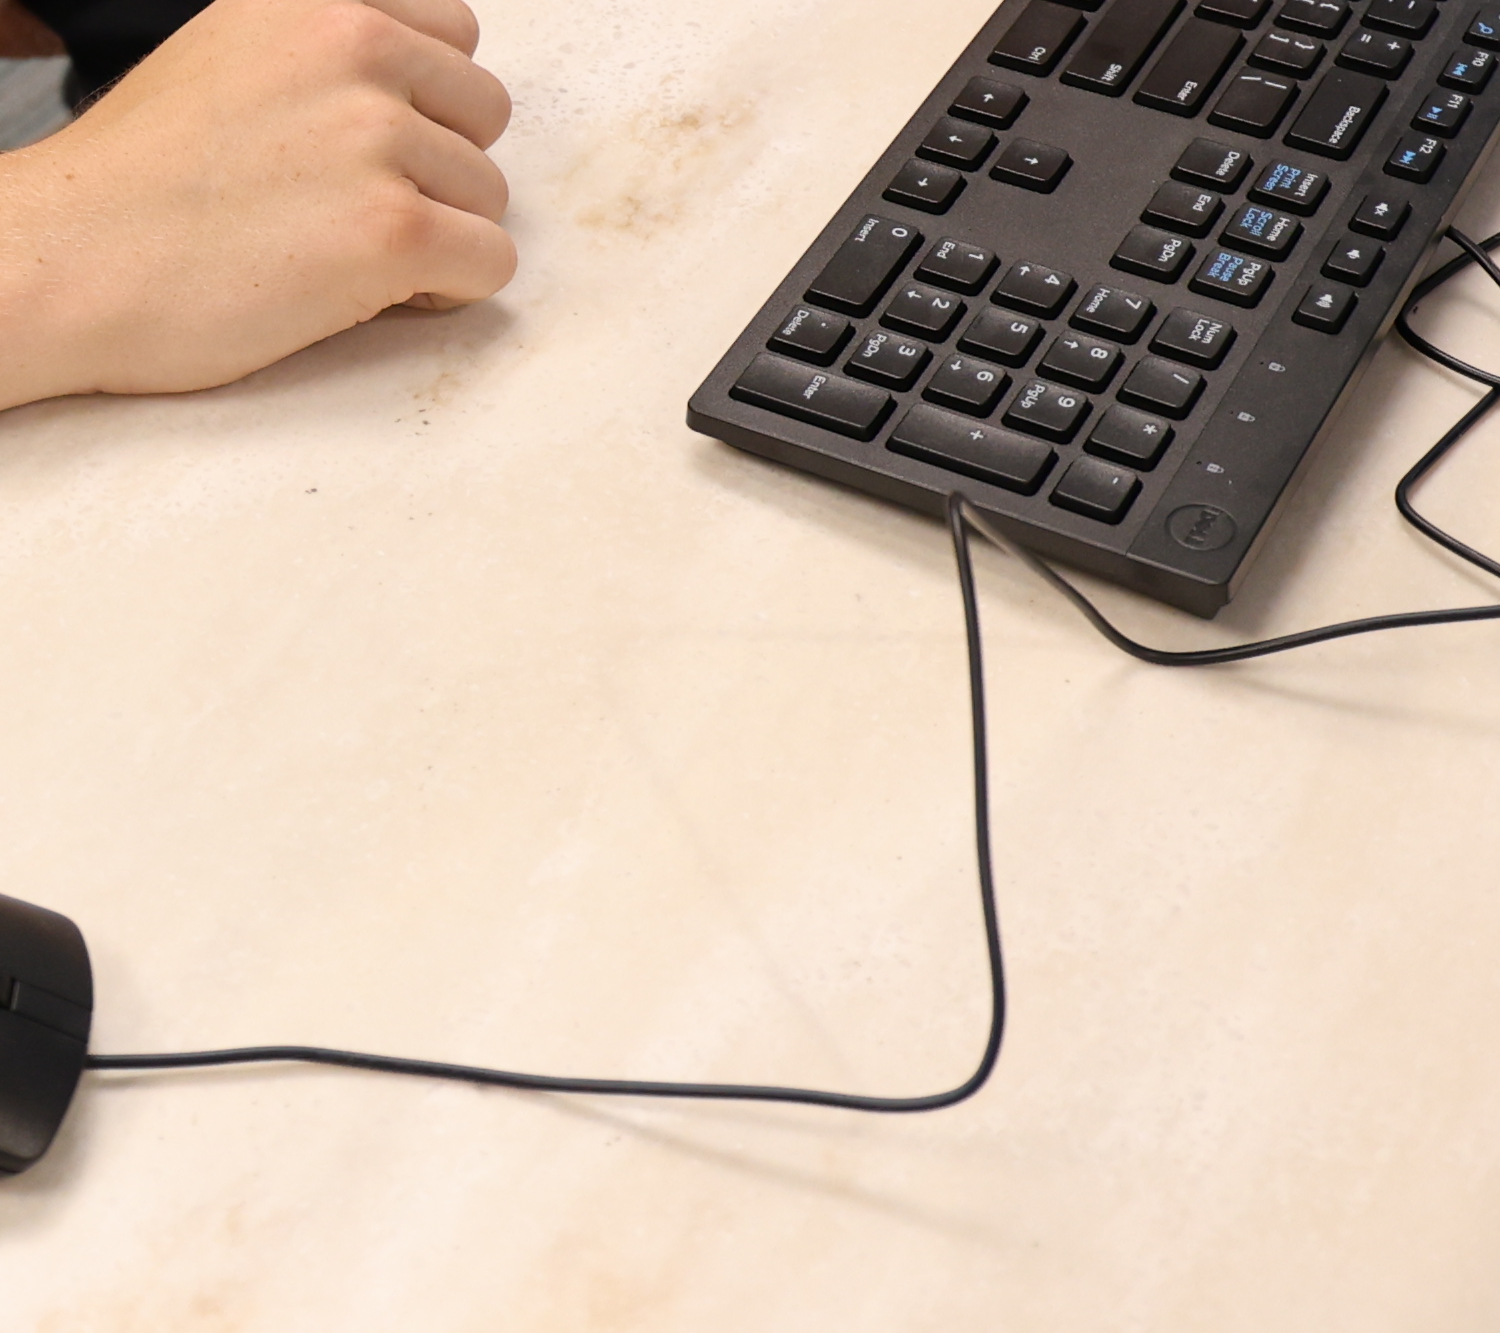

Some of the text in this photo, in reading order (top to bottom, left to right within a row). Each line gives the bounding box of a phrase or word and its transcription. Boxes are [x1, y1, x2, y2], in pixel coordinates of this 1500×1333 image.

[1028, 45, 1047, 61] Ctrl
[1471, 50, 1490, 68] F10
[1100, 61, 1123, 82] Shift
[1175, 79, 1199, 102] Enter
[1446, 93, 1465, 110] F11
[1326, 105, 1362, 145] Backspace
[1420, 137, 1439, 155] F12
[1214, 150, 1241, 178] Delete
[1261, 162, 1291, 192] Screen
[1279, 167, 1303, 190] Print
[1293, 172, 1319, 198] Insert
[1191, 193, 1213, 213] End
[1240, 206, 1264, 229] Lock
[1249, 210, 1274, 238] Scroll
[853, 217, 881, 243] Insert
[1265, 216, 1292, 243] Home
[935, 240, 957, 260] End
[967, 252, 986, 262] 1
[1158, 237, 1183, 264] PgDn
[1206, 251, 1232, 279] Break
[1218, 256, 1245, 283] Pause
[1237, 261, 1263, 287] PgUp
[1044, 273, 1061, 287] 4
[931, 297, 951, 310] 2
[1086, 287, 1111, 315] Home
[1125, 297, 1143, 311] 7
[781, 308, 811, 337] Delete
[1009, 321, 1029, 334] 5
[1187, 318, 1213, 342] Lock
[1200, 322, 1224, 346] Num
[861, 333, 888, 359] PgDn
[897, 344, 917, 358] 3
[1089, 346, 1109, 360] 8
[802, 374, 828, 401] Enter
[975, 370, 995, 383] 6
[1020, 383, 1046, 411] PgUp
[1057, 396, 1077, 409] 9
